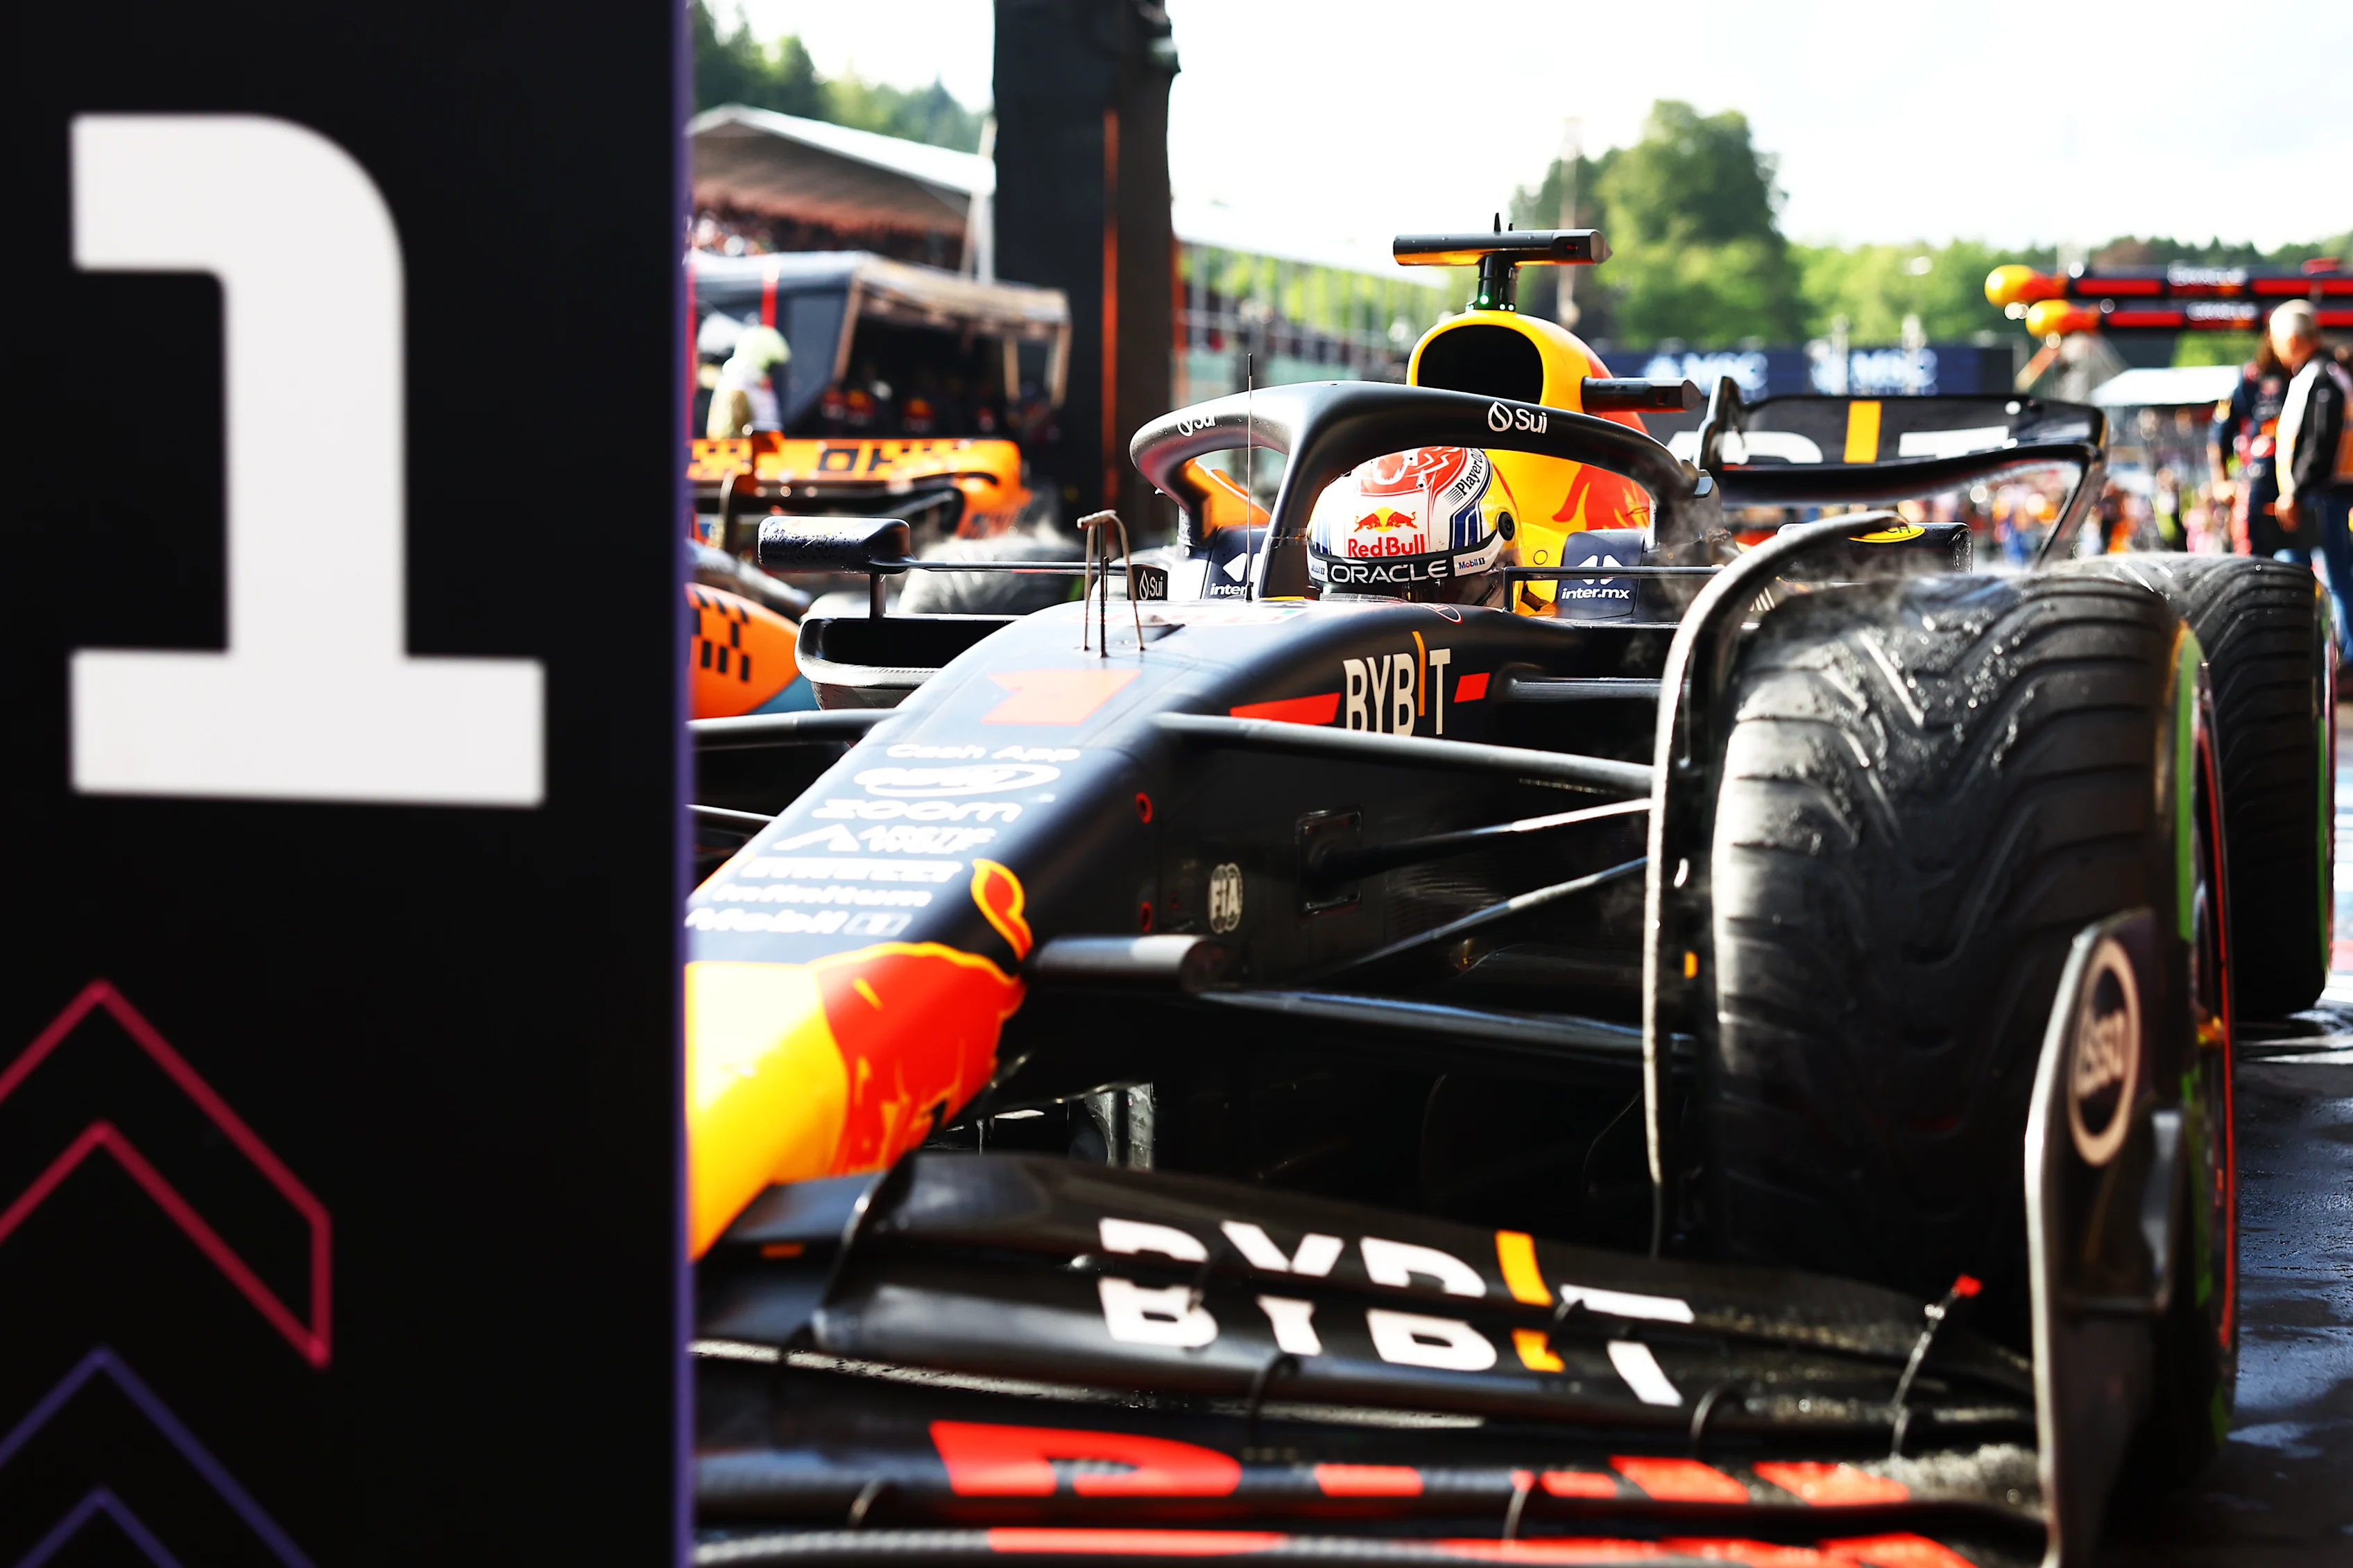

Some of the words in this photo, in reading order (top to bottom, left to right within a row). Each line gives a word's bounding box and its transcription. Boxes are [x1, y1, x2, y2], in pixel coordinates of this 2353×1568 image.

[1514, 408, 1548, 434] Sui
[70, 113, 544, 807] 1
[1454, 460, 1483, 497] Player
[1347, 536, 1383, 558] Red
[1386, 533, 1426, 555] Bull
[1330, 559, 1449, 584] ORACLE
[1458, 559, 1478, 569] Mobil
[1149, 576, 1163, 597] Sui
[1561, 588, 1630, 600] inter.mx
[1342, 630, 1451, 738] BYBIT
[886, 744, 987, 759] Cash
[991, 746, 1081, 762] App
[1097, 1216, 1695, 1386] BYBIT
